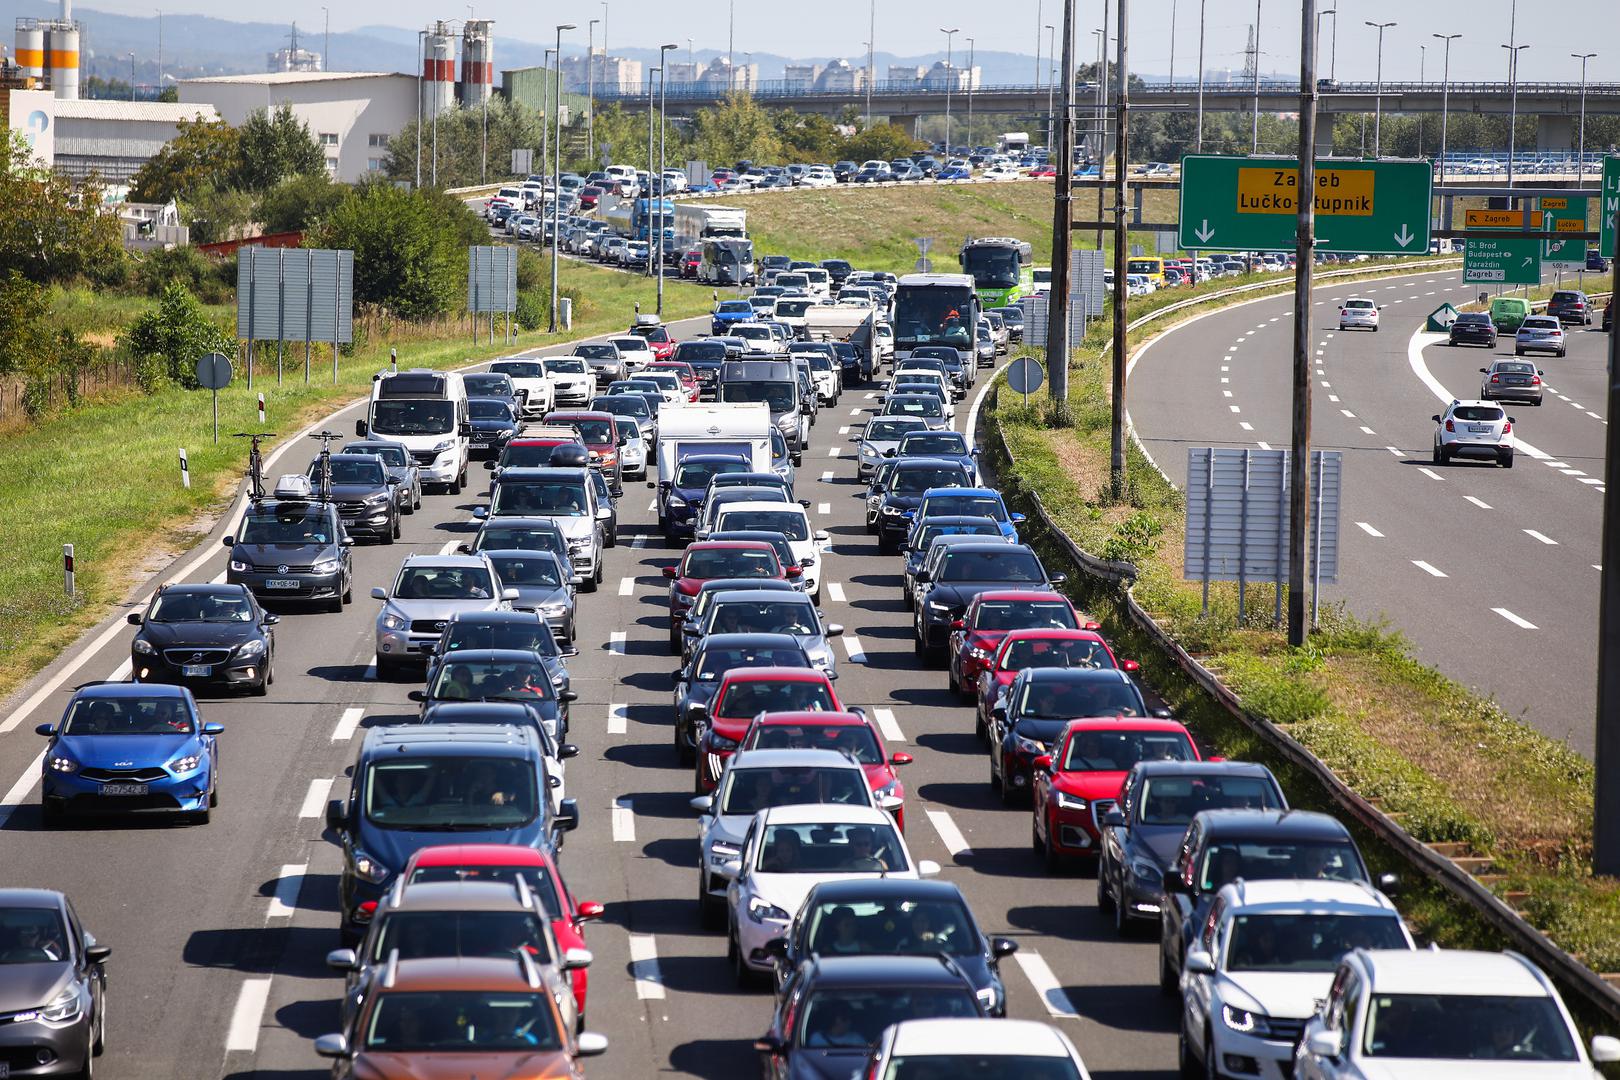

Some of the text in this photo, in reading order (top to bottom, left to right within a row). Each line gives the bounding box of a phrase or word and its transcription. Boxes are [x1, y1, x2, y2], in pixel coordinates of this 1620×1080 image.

[1274, 172, 1340, 187] Zaeb
[1241, 193, 1370, 213] Lučko-tupnik
[1543, 200, 1566, 208] Zagreb
[1468, 260, 1500, 268] Varaždin
[1467, 270, 1493, 278] Zagreb
